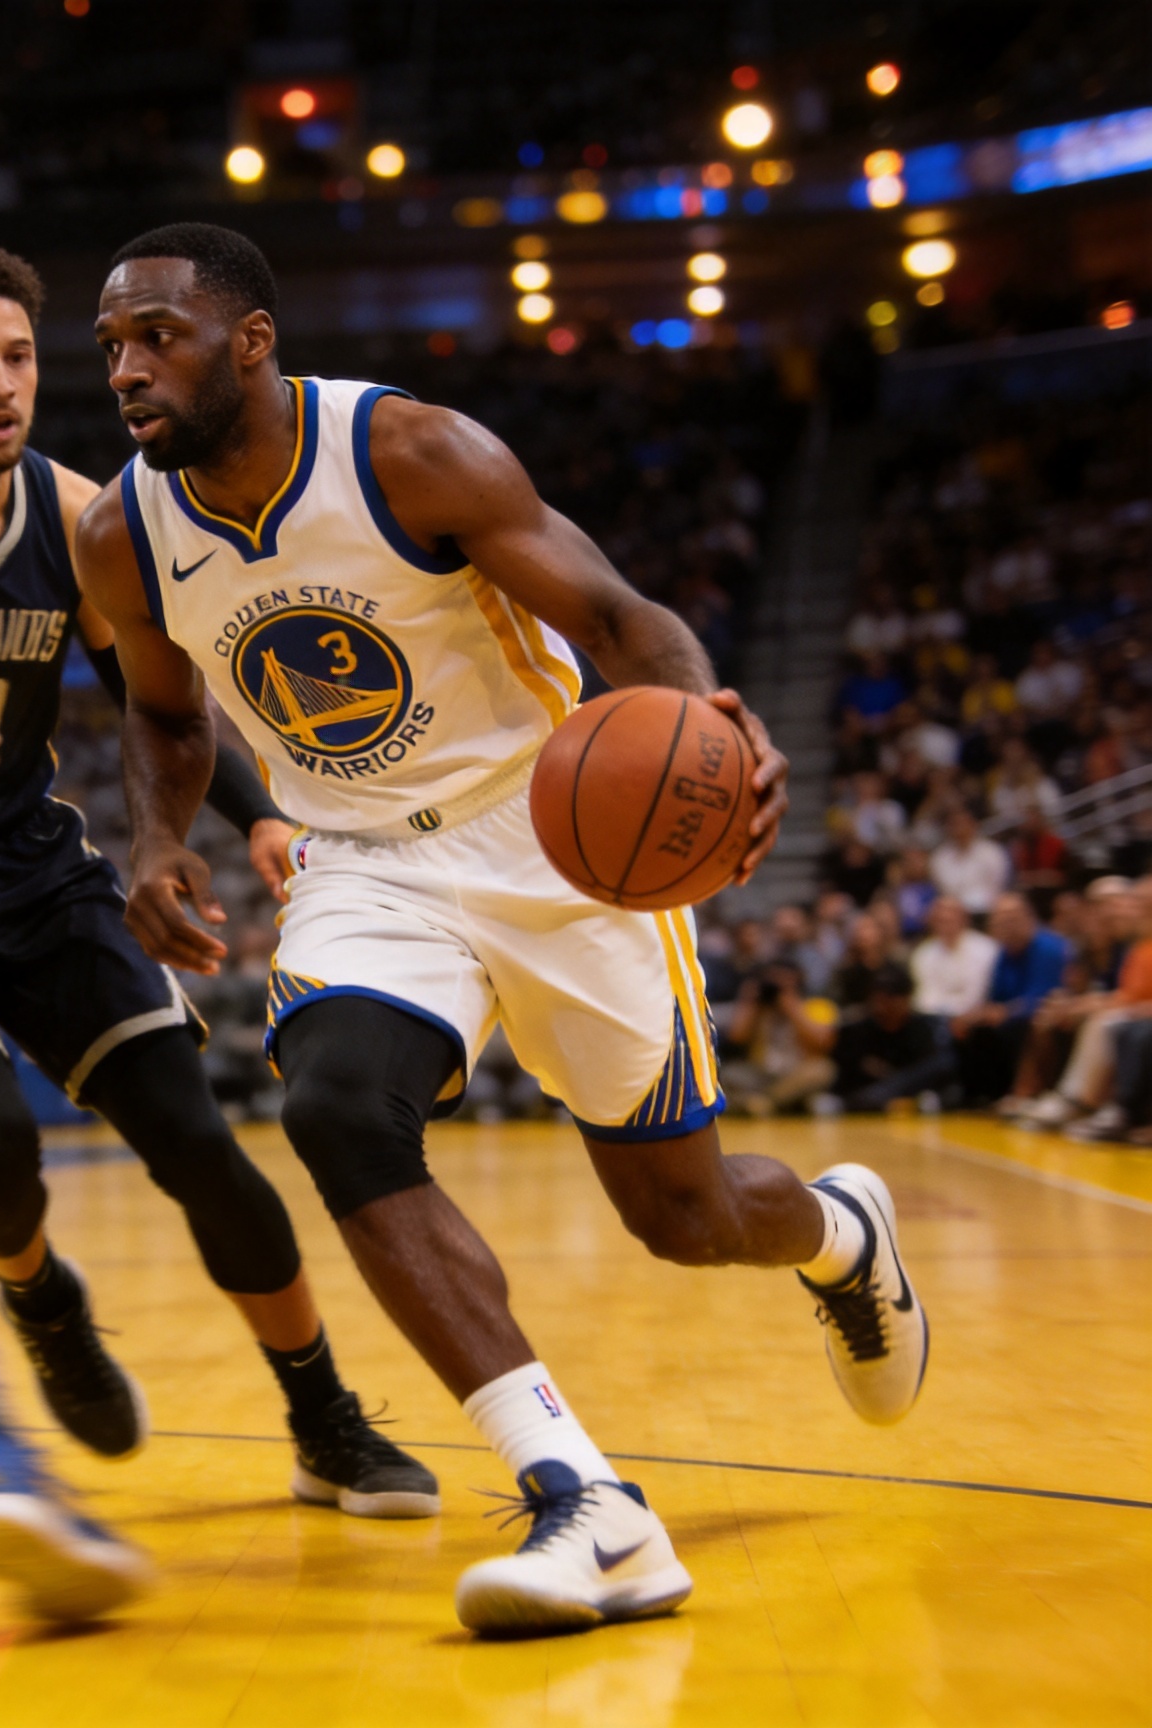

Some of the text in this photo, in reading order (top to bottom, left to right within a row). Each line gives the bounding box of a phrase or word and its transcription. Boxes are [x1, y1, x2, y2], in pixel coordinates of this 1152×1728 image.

[300, 585, 380, 620] STATE
[317, 629, 359, 676] 3
[276, 700, 435, 781] WARRIORS
